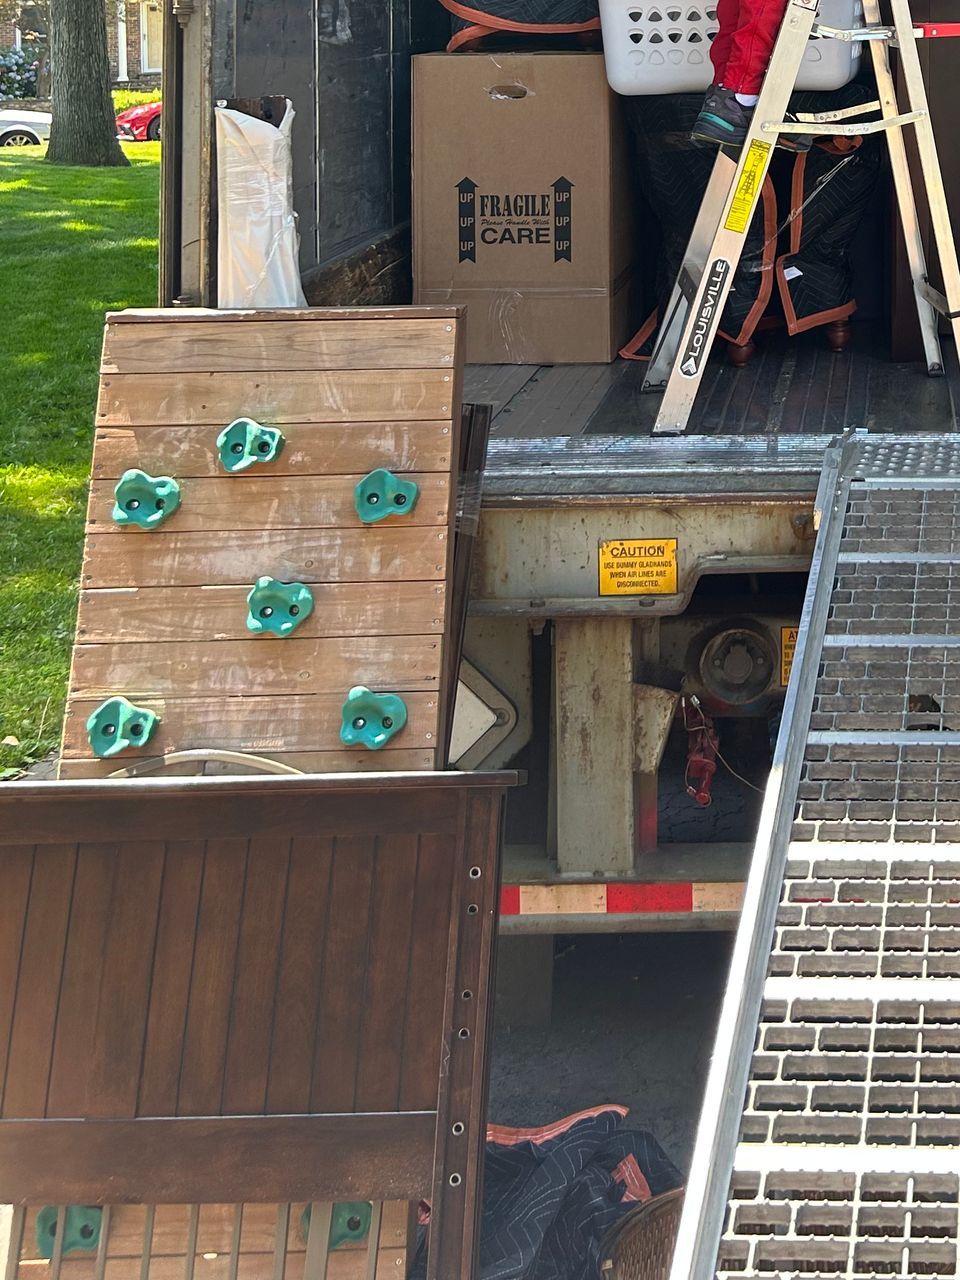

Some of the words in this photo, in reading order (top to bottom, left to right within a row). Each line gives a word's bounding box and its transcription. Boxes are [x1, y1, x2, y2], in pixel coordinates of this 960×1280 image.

[460, 193, 474, 203] UP
[555, 192, 570, 202] UP
[480, 195, 550, 216] FRAGILE
[460, 217, 474, 227] UP
[555, 216, 570, 226] UP
[480, 228, 551, 244] CARE
[460, 241, 474, 251] UP
[555, 241, 570, 251] UP
[688, 261, 726, 357] LOUISVILLE
[610, 546, 664, 557] CAUTION
[639, 560, 672, 568] GLADHANDS
[610, 571, 626, 579] WHEN
